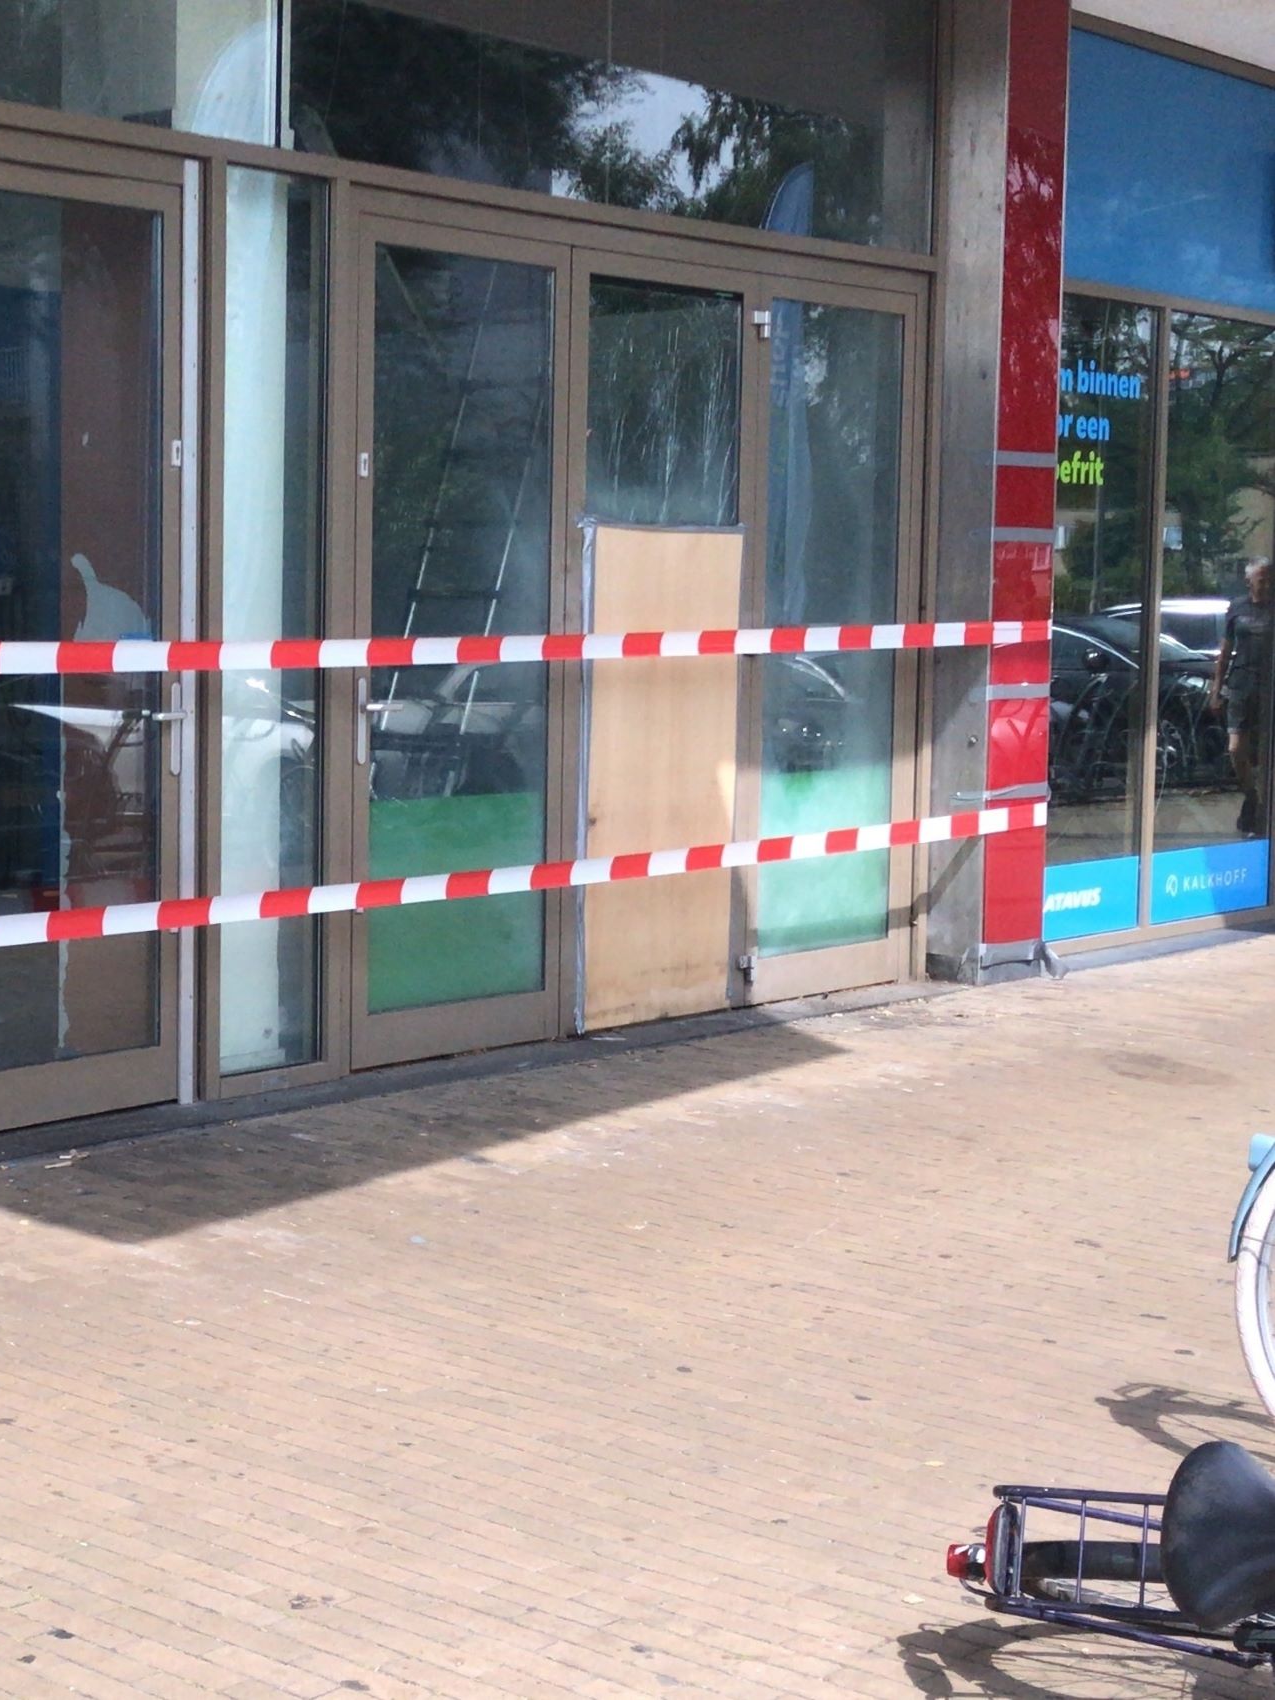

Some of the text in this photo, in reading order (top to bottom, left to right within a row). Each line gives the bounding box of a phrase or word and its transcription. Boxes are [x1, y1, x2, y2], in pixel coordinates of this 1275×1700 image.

[1077, 359, 1141, 399] binnen
[1056, 413, 1111, 441] or een
[1056, 450, 1104, 486] efrit
[1183, 867, 1248, 892] KALKHOFF
[1044, 888, 1101, 912] ATAVUS
